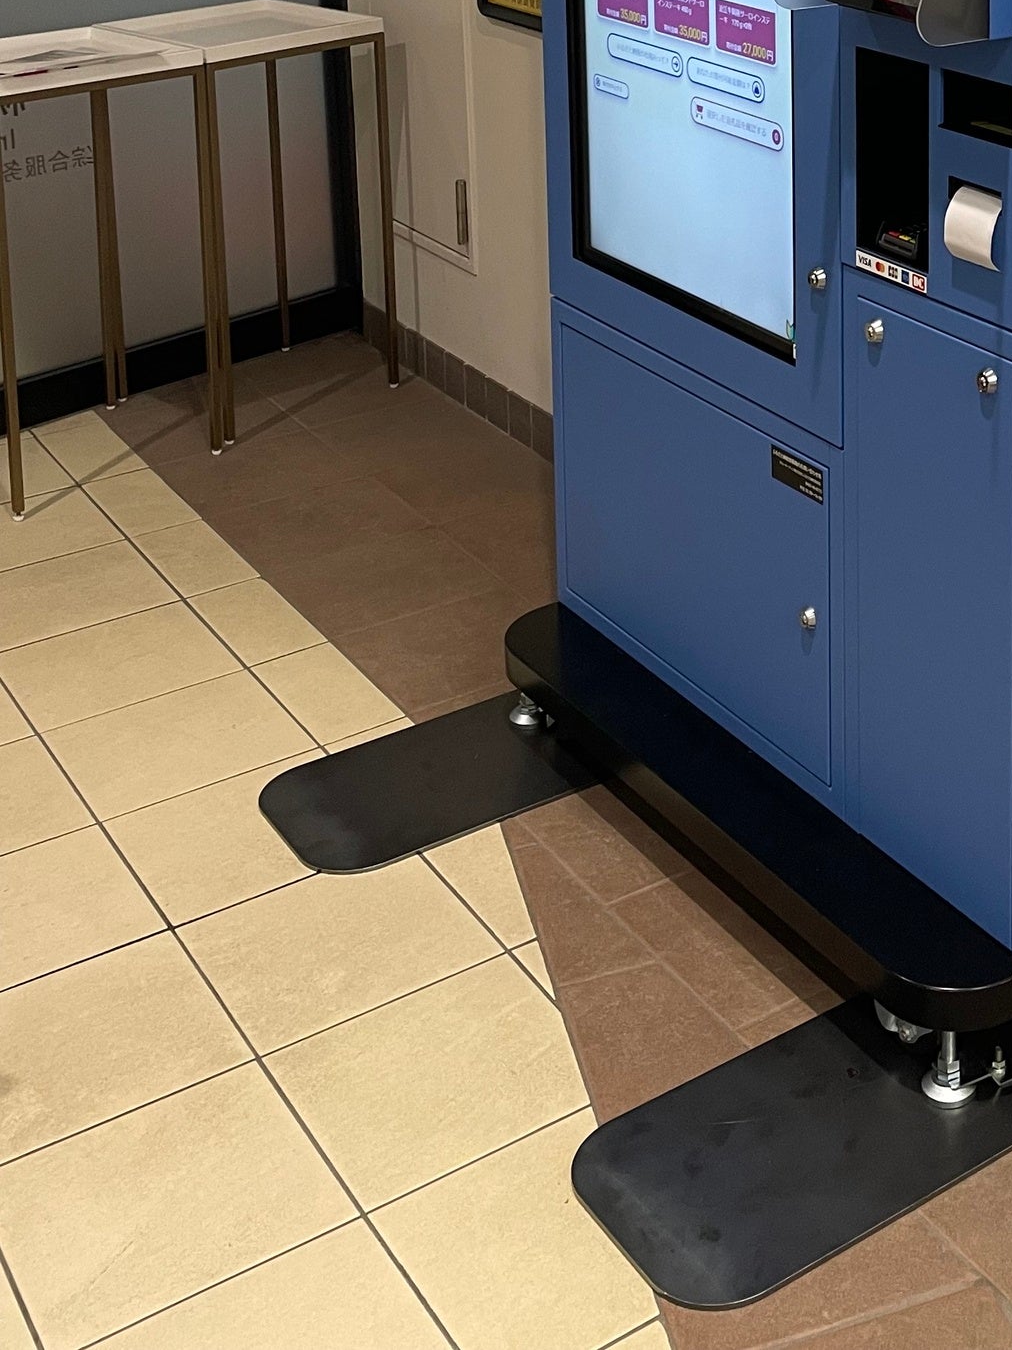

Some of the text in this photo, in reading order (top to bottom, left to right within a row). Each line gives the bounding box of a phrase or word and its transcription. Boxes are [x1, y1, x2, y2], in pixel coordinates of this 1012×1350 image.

[678, 24, 708, 43] 35,000円
[741, 42, 774, 61] 27,000円
[858, 254, 872, 268] VISA
